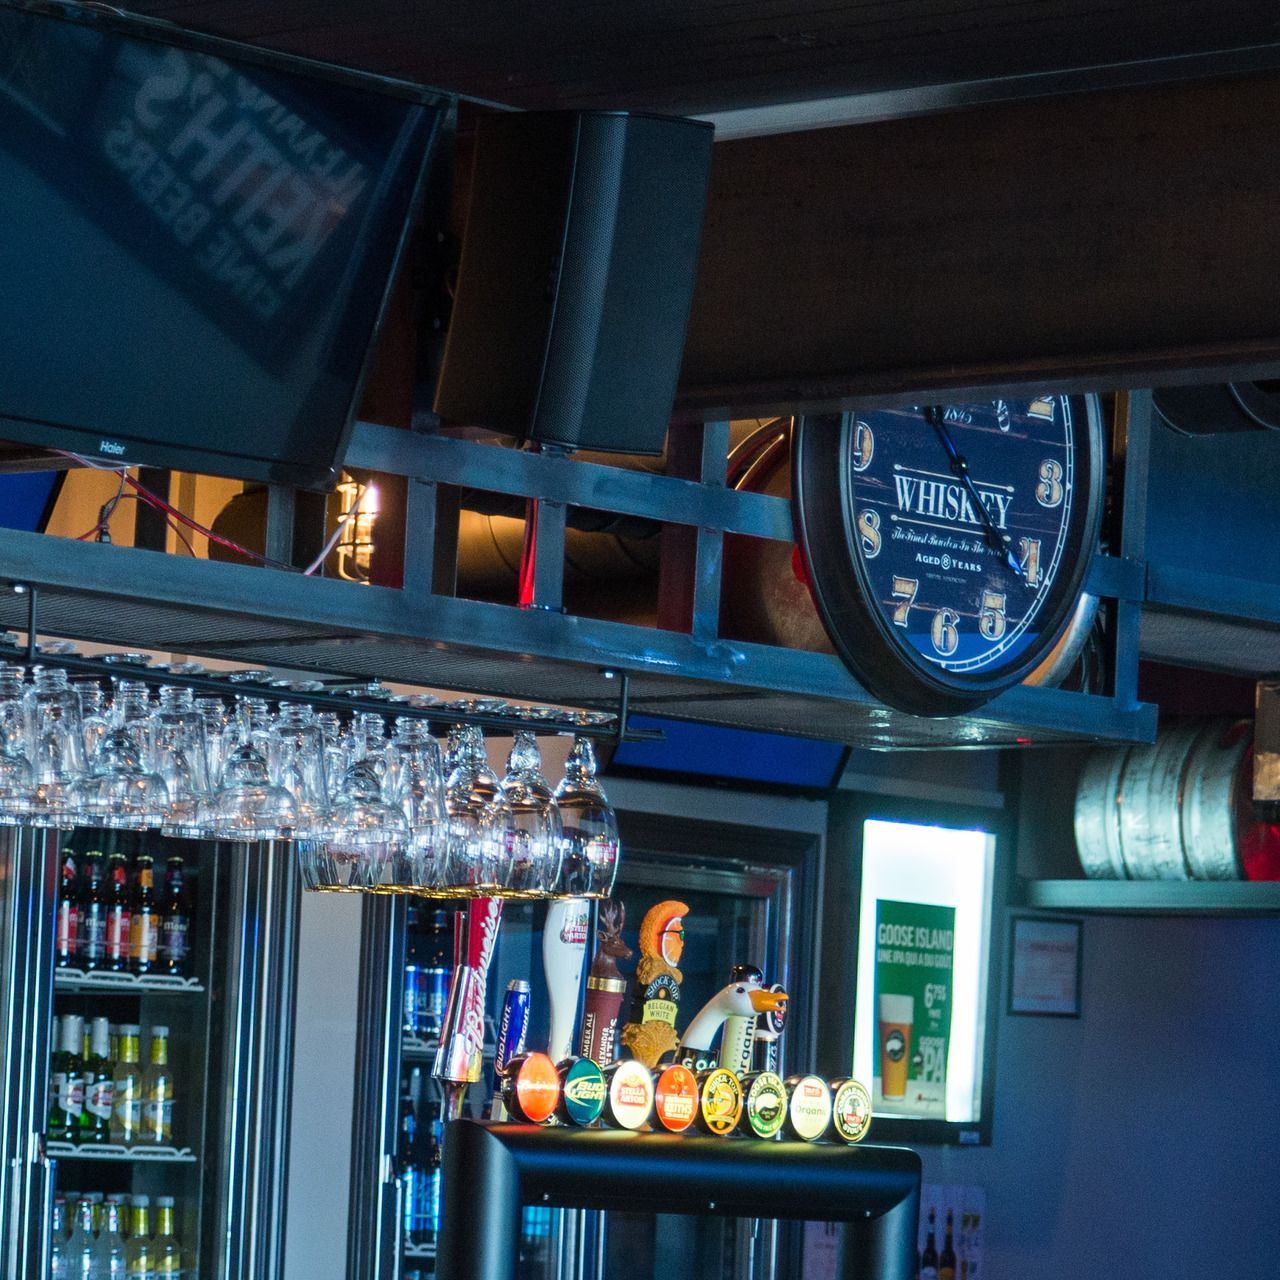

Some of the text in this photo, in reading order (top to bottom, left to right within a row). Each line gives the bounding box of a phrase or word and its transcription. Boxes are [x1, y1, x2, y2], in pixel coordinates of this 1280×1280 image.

[100, 440, 126, 455] Haier
[1036, 459, 1063, 508] 3
[893, 474, 1013, 530] WHISKEY
[858, 509, 881, 559] 8
[915, 553, 941, 566] AGED
[952, 559, 982, 572] YEARS
[1019, 536, 1043, 588] 4
[892, 575, 918, 627] 7
[979, 590, 1006, 641] 5
[931, 607, 960, 656] 6
[878, 923, 953, 950] GOOSE ISLAND
[647, 975, 680, 1001] SHOCK TOP
[647, 1002, 674, 1012] BELGIAN
[649, 1011, 670, 1019] WHITE
[496, 1041, 507, 1071] BUD
[582, 1026, 591, 1058] AMBER
[598, 1027, 609, 1068] ALEXANDER
[606, 1018, 617, 1064] EITH'S
[571, 1090, 604, 1101] LIGHT
[576, 1082, 604, 1092] BUD
[620, 1086, 646, 1096] STELLA
